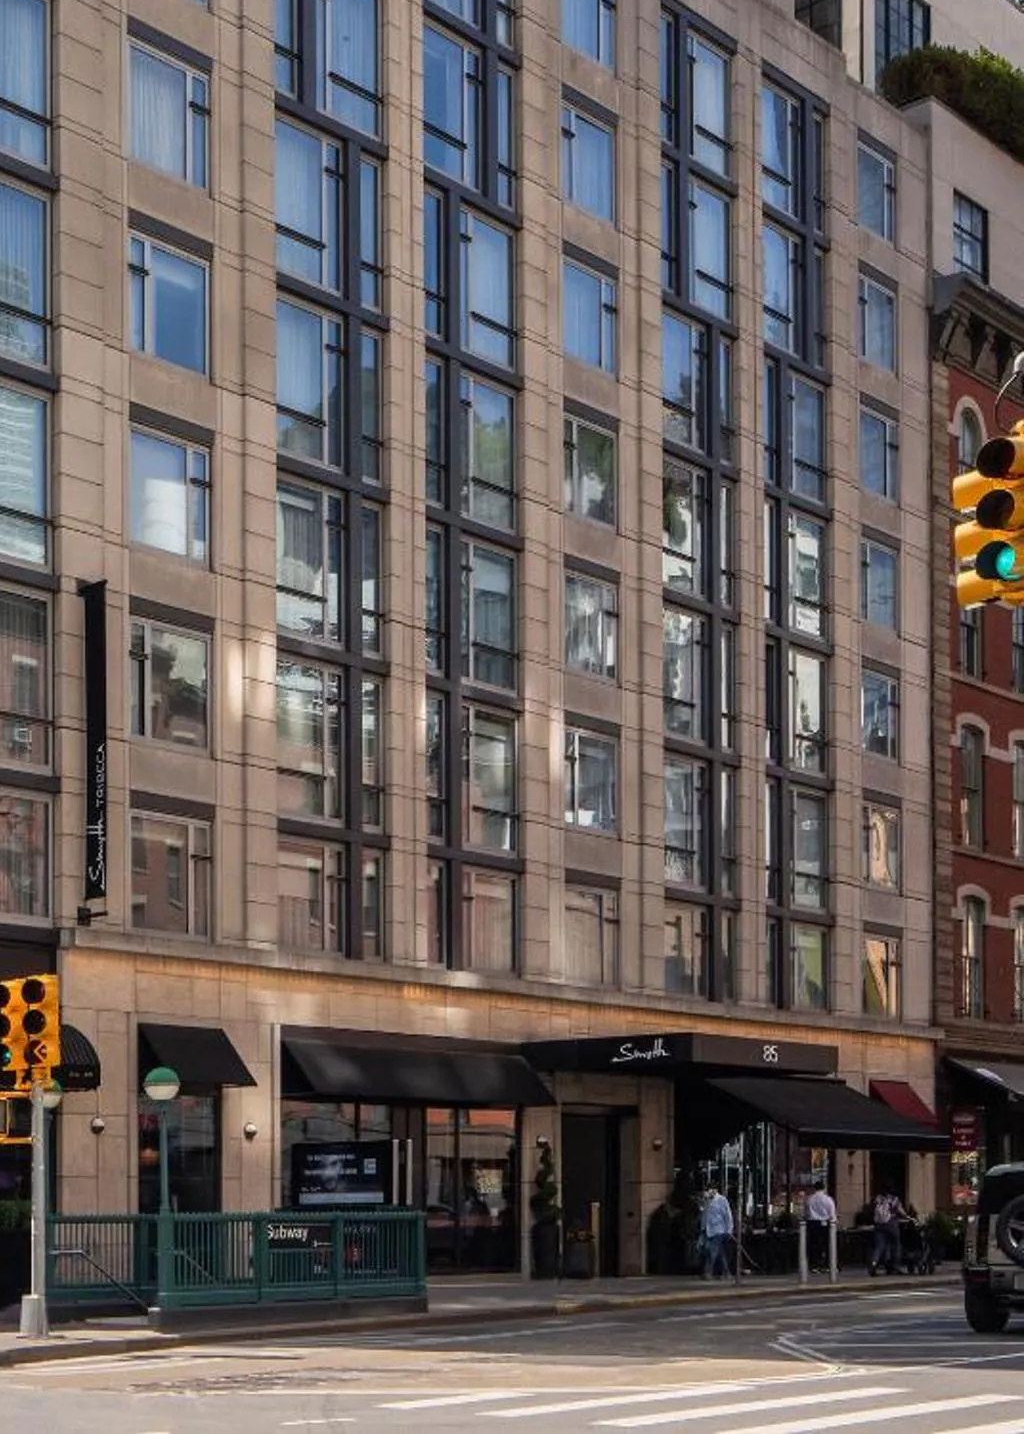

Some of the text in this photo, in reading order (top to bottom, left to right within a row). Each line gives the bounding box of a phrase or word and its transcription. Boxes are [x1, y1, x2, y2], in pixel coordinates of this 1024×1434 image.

[86, 743, 106, 891] Smyth TRIBECA
[612, 1038, 669, 1062] Smyth
[763, 1045, 779, 1062] 85
[267, 1224, 310, 1242] Subway
